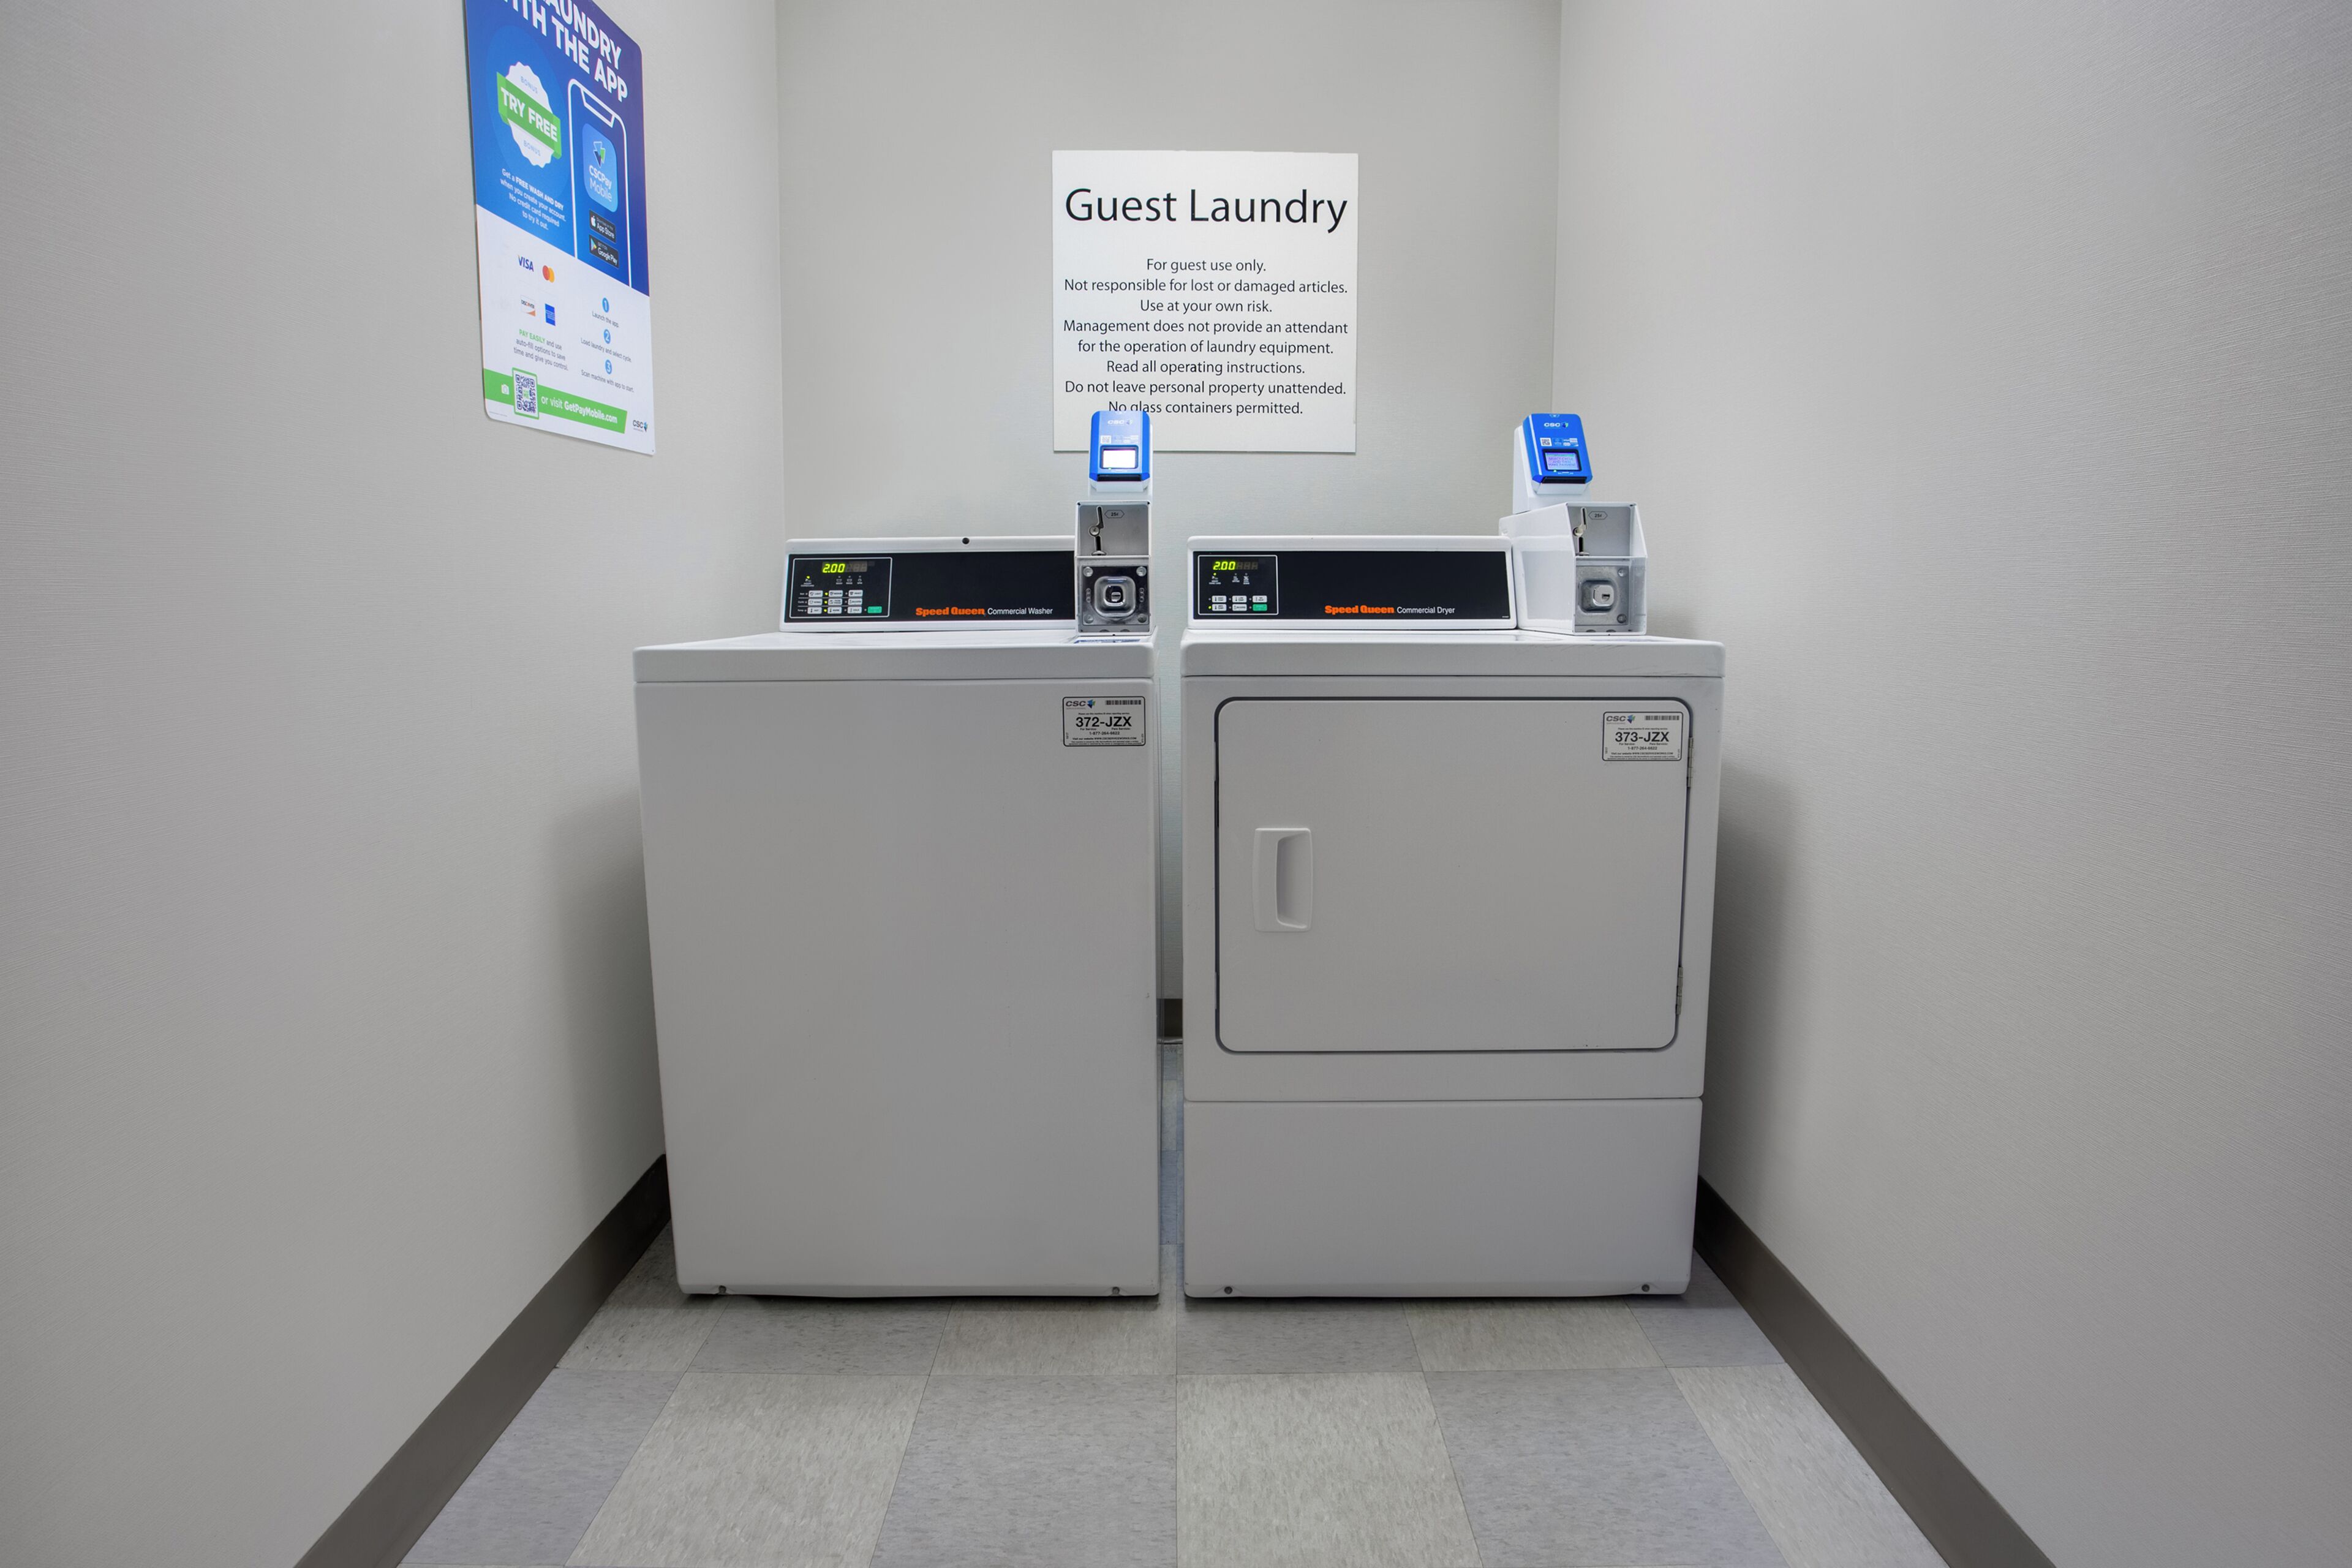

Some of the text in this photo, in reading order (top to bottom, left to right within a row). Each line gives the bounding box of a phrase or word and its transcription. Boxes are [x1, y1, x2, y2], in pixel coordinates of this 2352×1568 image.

[551, 15, 590, 74] THE
[594, 58, 628, 102] APP
[500, 87, 558, 143] TRY FREE
[589, 165, 612, 189] CSCPay
[501, 168, 511, 181] Get
[515, 176, 529, 190] FREE
[529, 183, 544, 199] WASH
[544, 192, 554, 205] AND
[554, 198, 564, 211] DRY
[590, 177, 612, 202] Mobile
[500, 178, 567, 222] when you create your account.
[509, 192, 560, 227] No credit card required
[1066, 189, 1347, 233] Guest Laundry
[597, 222, 606, 233] App
[605, 227, 615, 239] Store
[518, 254, 534, 272] VISA
[598, 247, 618, 265] Google Play
[1147, 258, 1266, 274] For guest use only.
[1065, 278, 1348, 295] Not responsible for lost or damaged articles.
[592, 311, 605, 321] Launch
[1140, 300, 1272, 315] Use at your own risk.
[1063, 319, 1348, 335] Management does not provide an attendant
[519, 328, 528, 337] PAY
[529, 332, 545, 344] EASILY
[516, 338, 534, 349] auto-fill
[535, 344, 551, 356] options
[581, 337, 590, 347] Load
[591, 341, 605, 353] laundry
[612, 350, 622, 359] select
[1077, 339, 1333, 356] for the operation of laundry equipment.
[513, 347, 524, 356] time
[535, 354, 544, 363] give
[553, 360, 568, 371] control.
[581, 369, 590, 378] Scan
[591, 373, 606, 383] machine
[1107, 360, 1305, 376] Read all operating instructions.
[1065, 380, 1346, 397] Do not leave personal property unattended.
[541, 396, 617, 424] or visit GetPayMobile.com
[1109, 401, 1127, 412] No
[1165, 401, 1232, 413] containers
[1236, 401, 1303, 416] permitted.
[633, 420, 643, 429] CSC
[823, 563, 845, 573] 2.00
[1213, 561, 1236, 570] 2.00
[915, 607, 949, 617] Speed
[951, 606, 985, 616] Queen
[1324, 605, 1359, 616] Speed
[1360, 605, 1394, 614] Queen
[1437, 606, 1455, 616] Dryer
[1076, 716, 1132, 727] 372-JZX
[1615, 731, 1670, 742] 373-JZX
